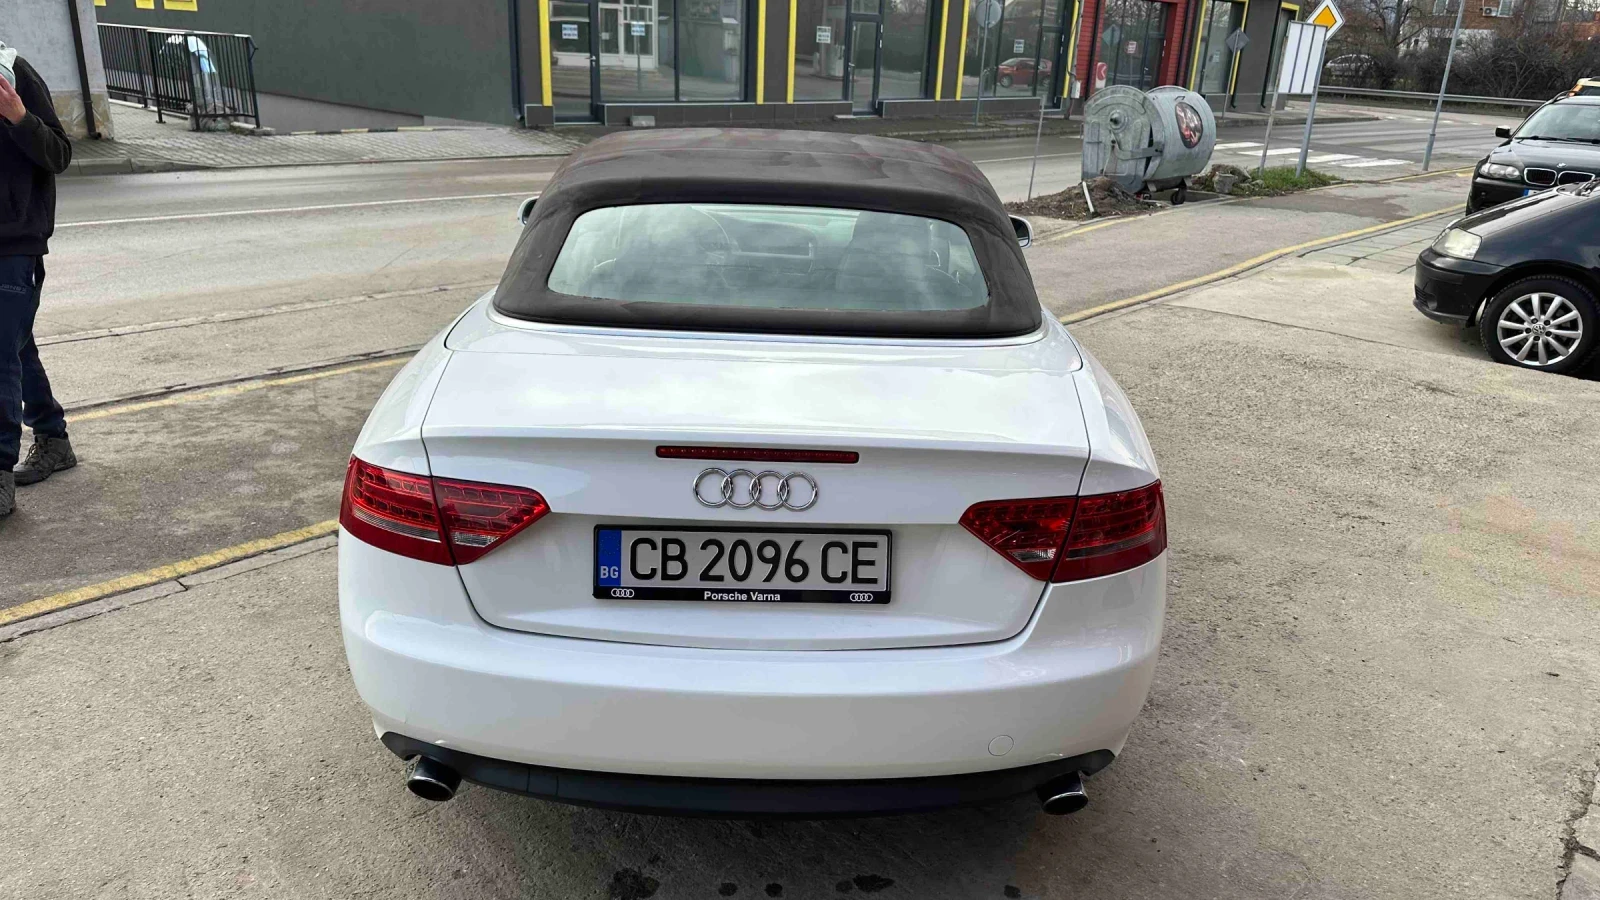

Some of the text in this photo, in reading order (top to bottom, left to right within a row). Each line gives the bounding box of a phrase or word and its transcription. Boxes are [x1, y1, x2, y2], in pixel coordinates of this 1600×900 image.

[630, 537, 878, 584] CB 2096 CE
[600, 565, 619, 579] BG
[704, 590, 781, 601] Porsche Varna
